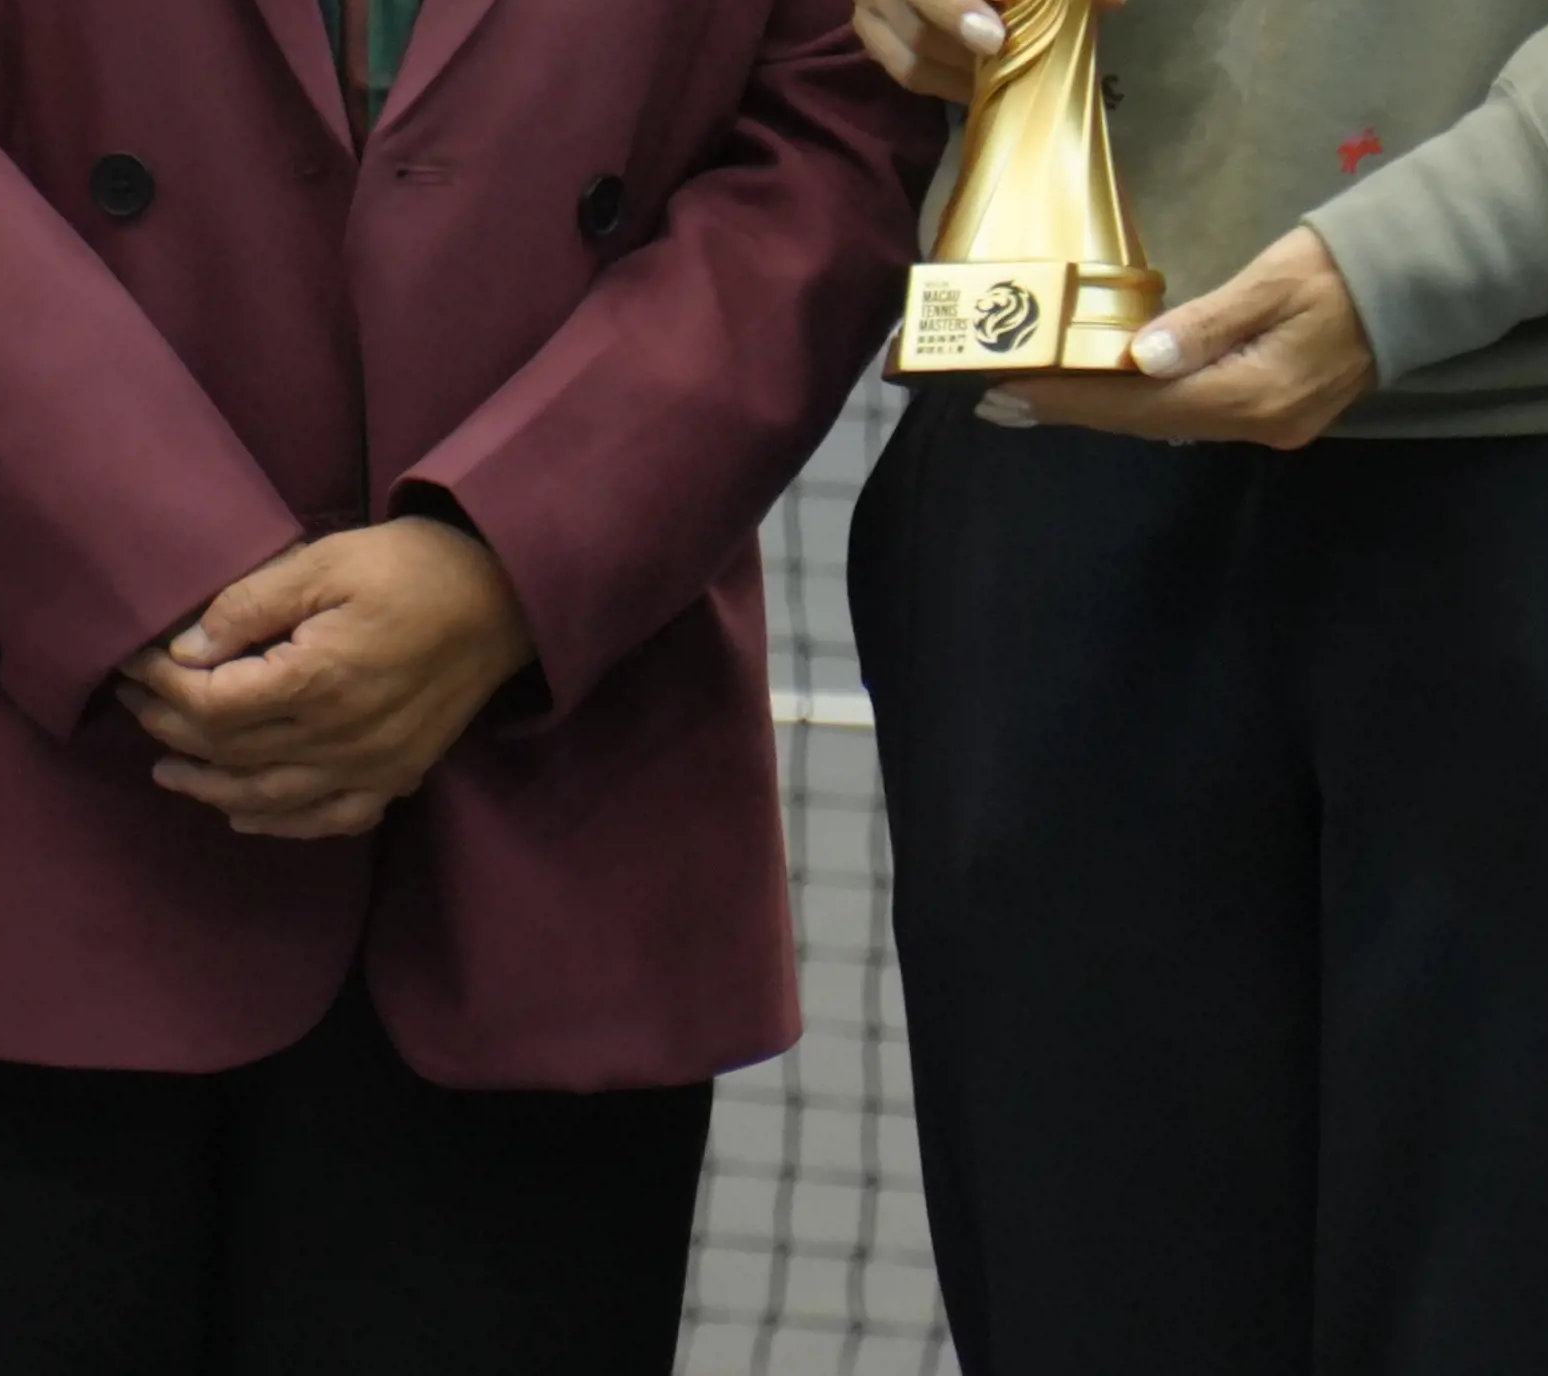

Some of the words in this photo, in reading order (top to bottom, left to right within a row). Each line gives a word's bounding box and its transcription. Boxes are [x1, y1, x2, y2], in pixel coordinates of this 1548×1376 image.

[922, 290, 961, 303] MACAU
[921, 303, 959, 318] TENNIS
[918, 318, 969, 332] MASTERS
